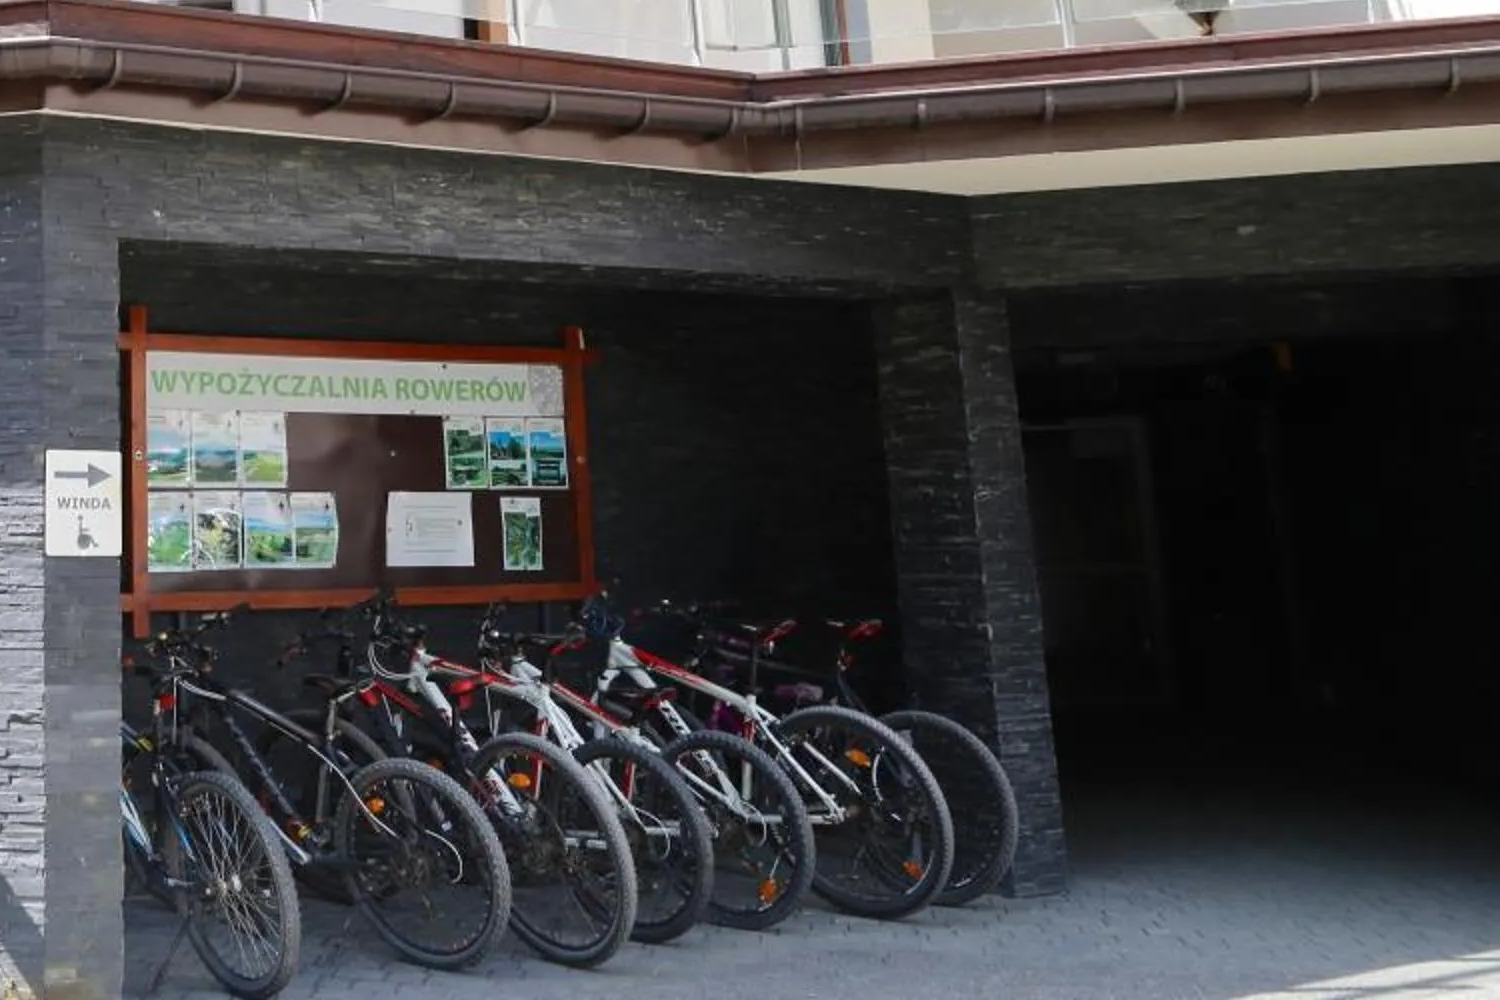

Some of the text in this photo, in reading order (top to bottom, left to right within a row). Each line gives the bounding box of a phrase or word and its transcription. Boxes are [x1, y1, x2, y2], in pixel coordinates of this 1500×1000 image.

[151, 367, 526, 402] WYPOŻYCZALNIA ROWERÓW
[57, 496, 112, 509] WINDA
